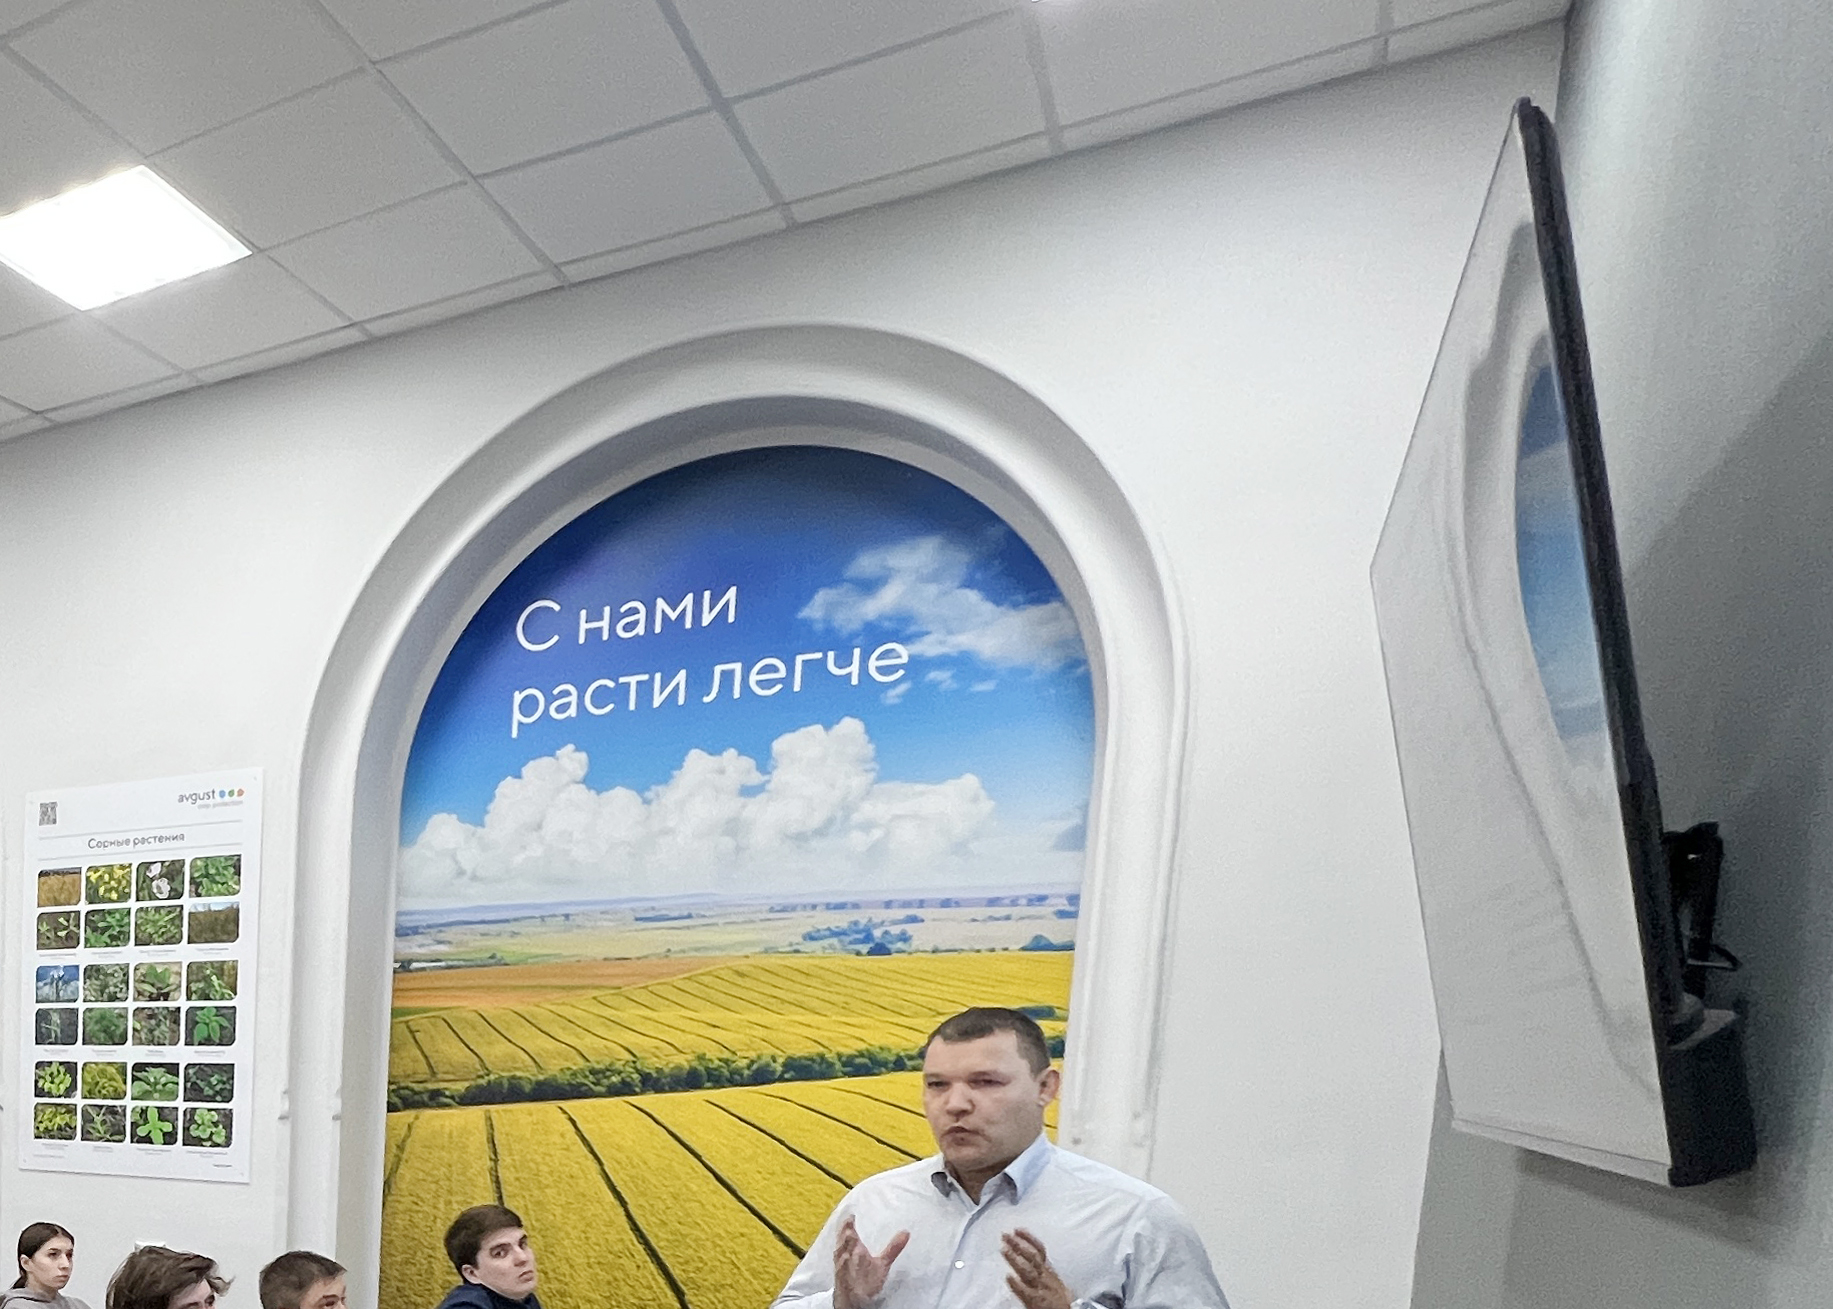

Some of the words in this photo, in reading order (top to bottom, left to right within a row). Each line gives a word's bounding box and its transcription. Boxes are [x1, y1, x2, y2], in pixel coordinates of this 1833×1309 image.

[516, 599, 561, 652] С
[577, 586, 738, 645] нами
[510, 668, 687, 738] расти
[702, 641, 910, 704] легче
[177, 788, 216, 805] avgust
